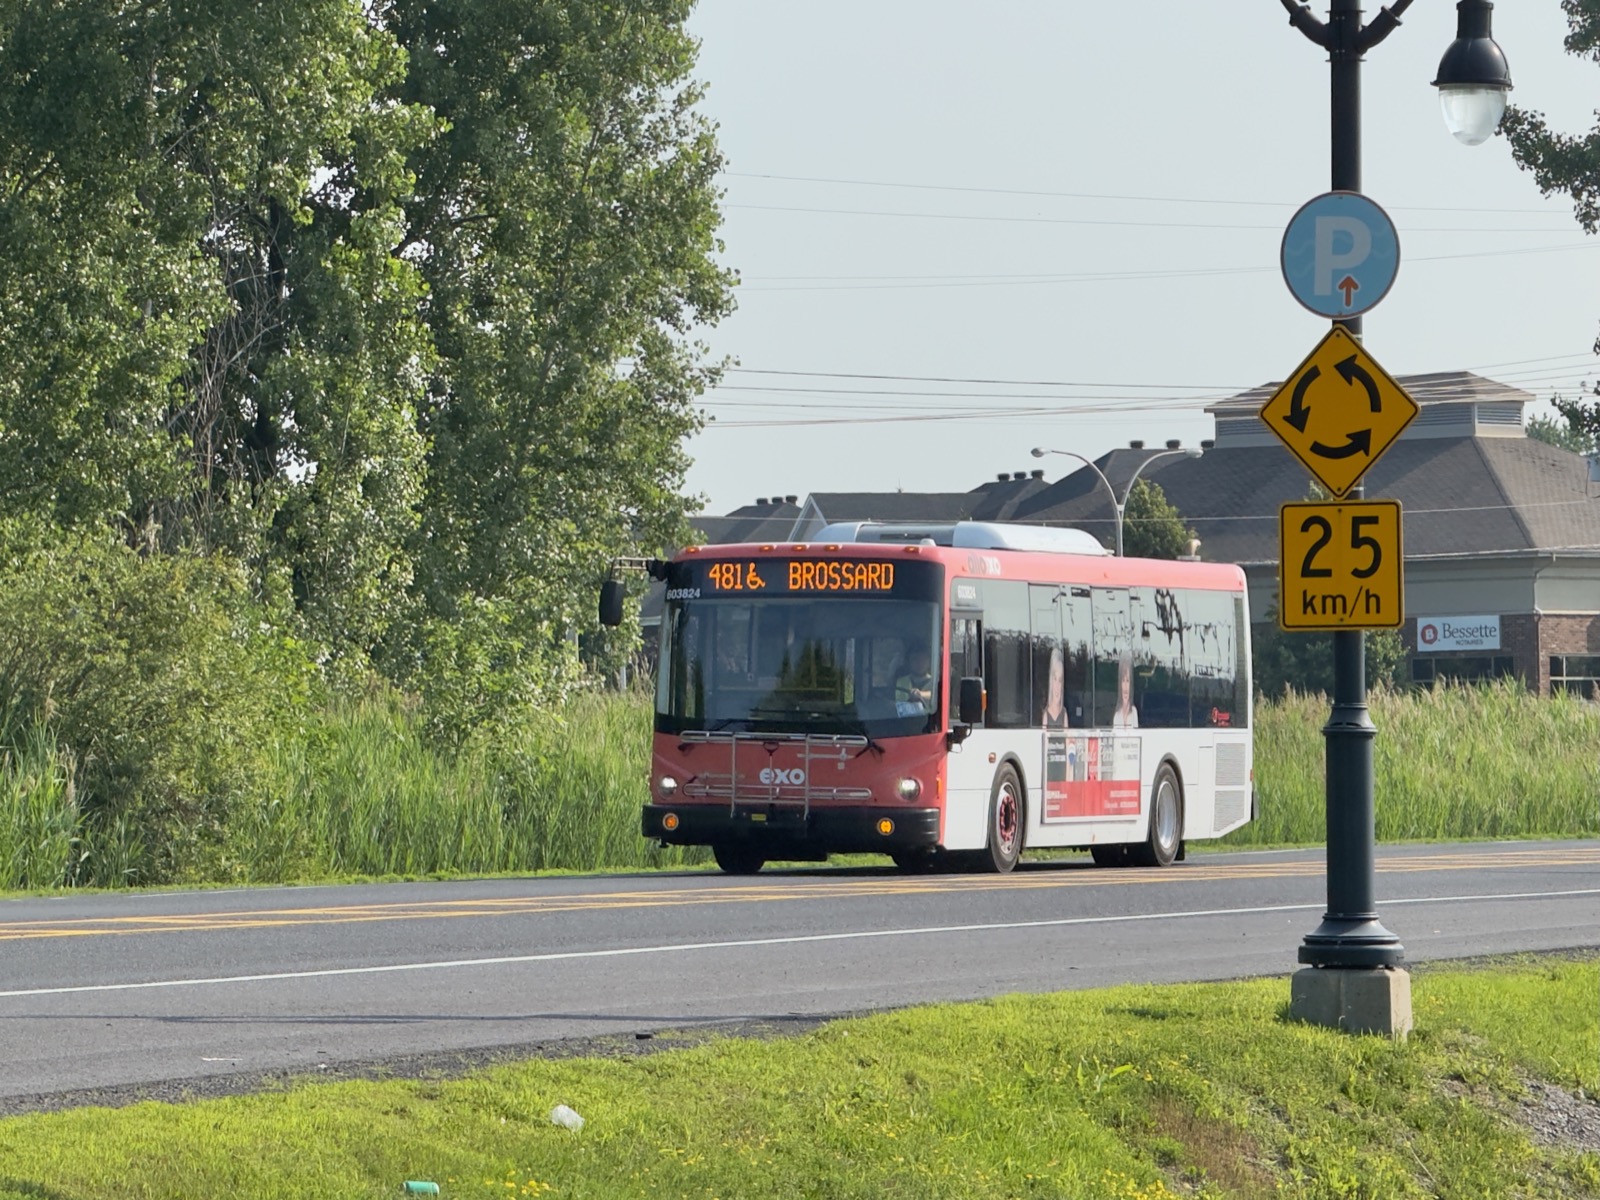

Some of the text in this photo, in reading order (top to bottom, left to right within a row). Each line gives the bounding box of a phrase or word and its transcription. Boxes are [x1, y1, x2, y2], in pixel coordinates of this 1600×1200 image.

[1314, 216, 1372, 296] P
[1300, 515, 1382, 579] 25
[708, 561, 895, 590] 481 BROSSARD
[666, 588, 701, 600] 603824
[1302, 585, 1382, 619] km/h
[1442, 622, 1497, 639] Bessette
[759, 768, 806, 785] exo
